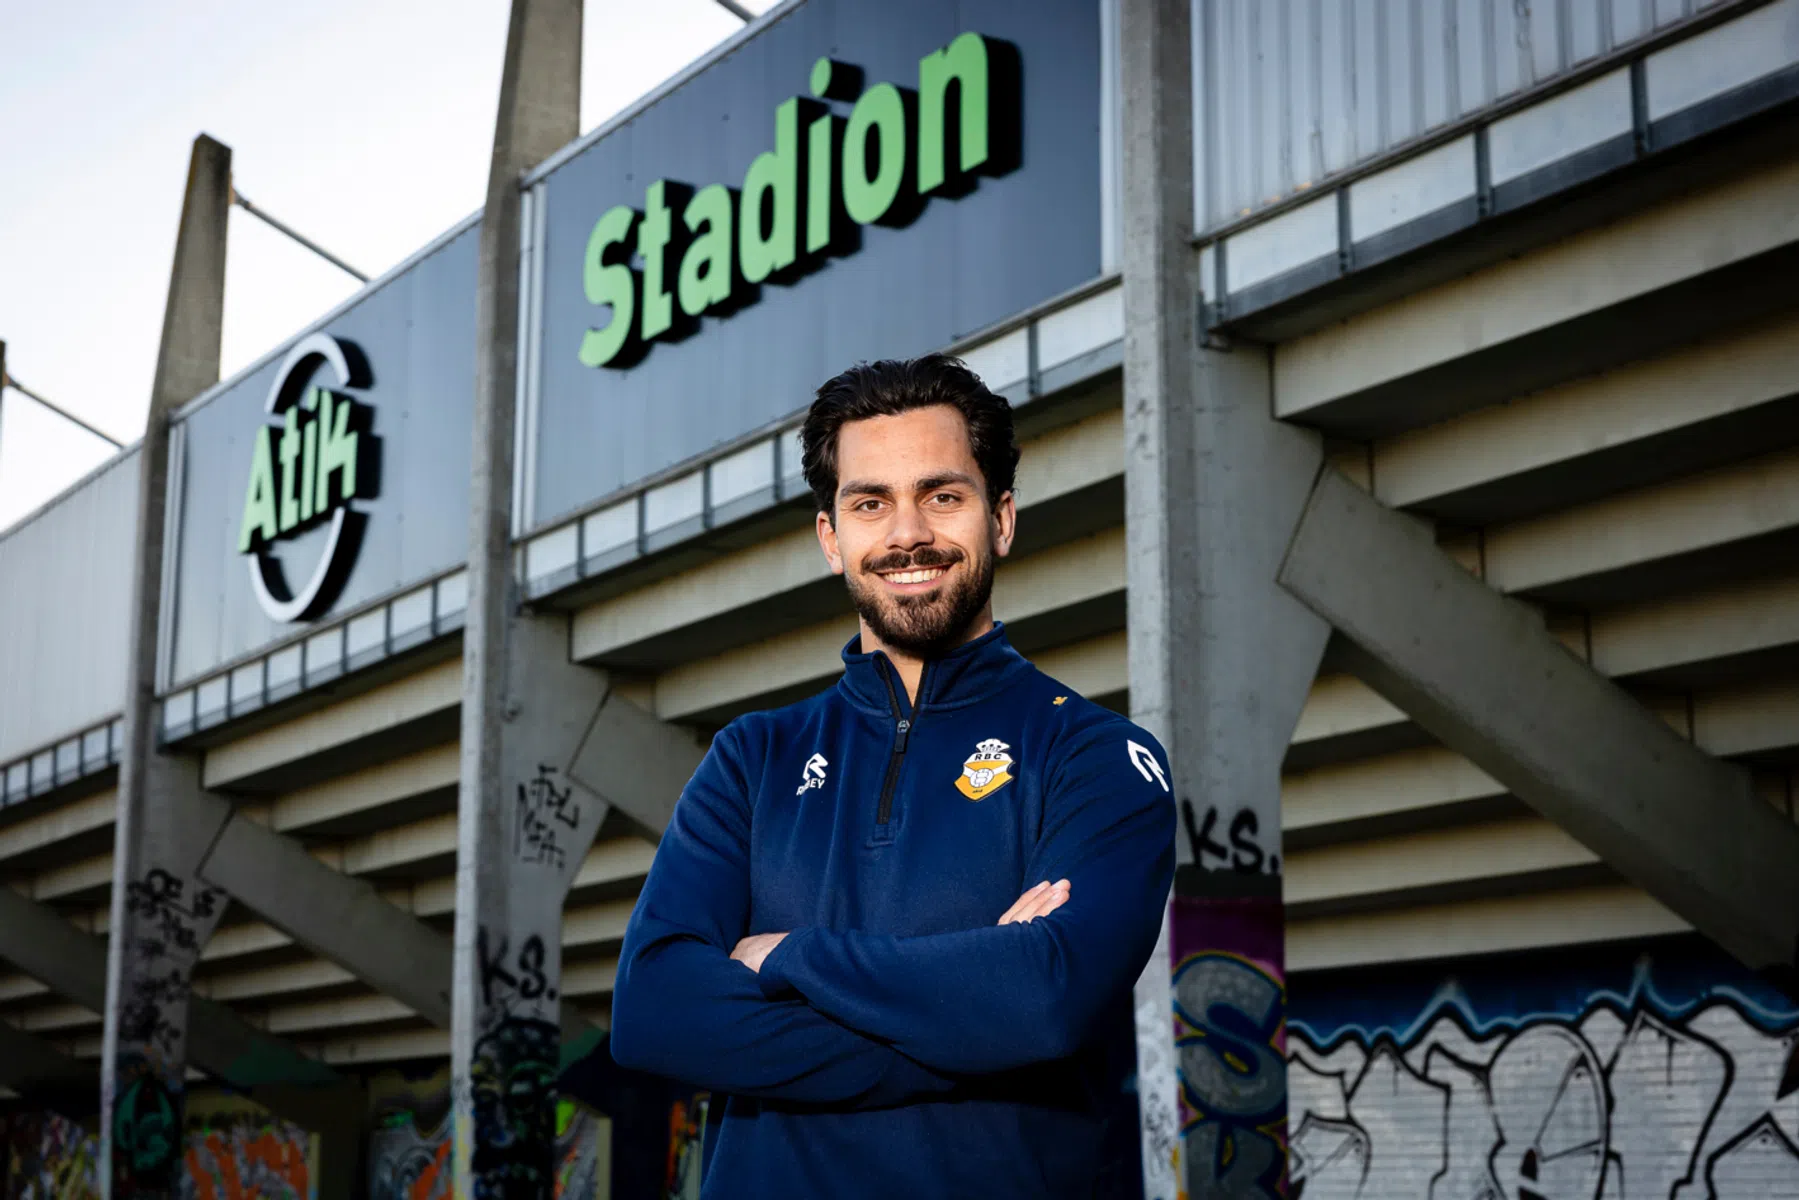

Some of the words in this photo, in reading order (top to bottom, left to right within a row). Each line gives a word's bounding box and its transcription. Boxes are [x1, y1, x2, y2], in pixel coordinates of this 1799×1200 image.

[579, 32, 989, 368] Stadion
[237, 385, 358, 553] Atik
[974, 753, 1002, 761] RBC
